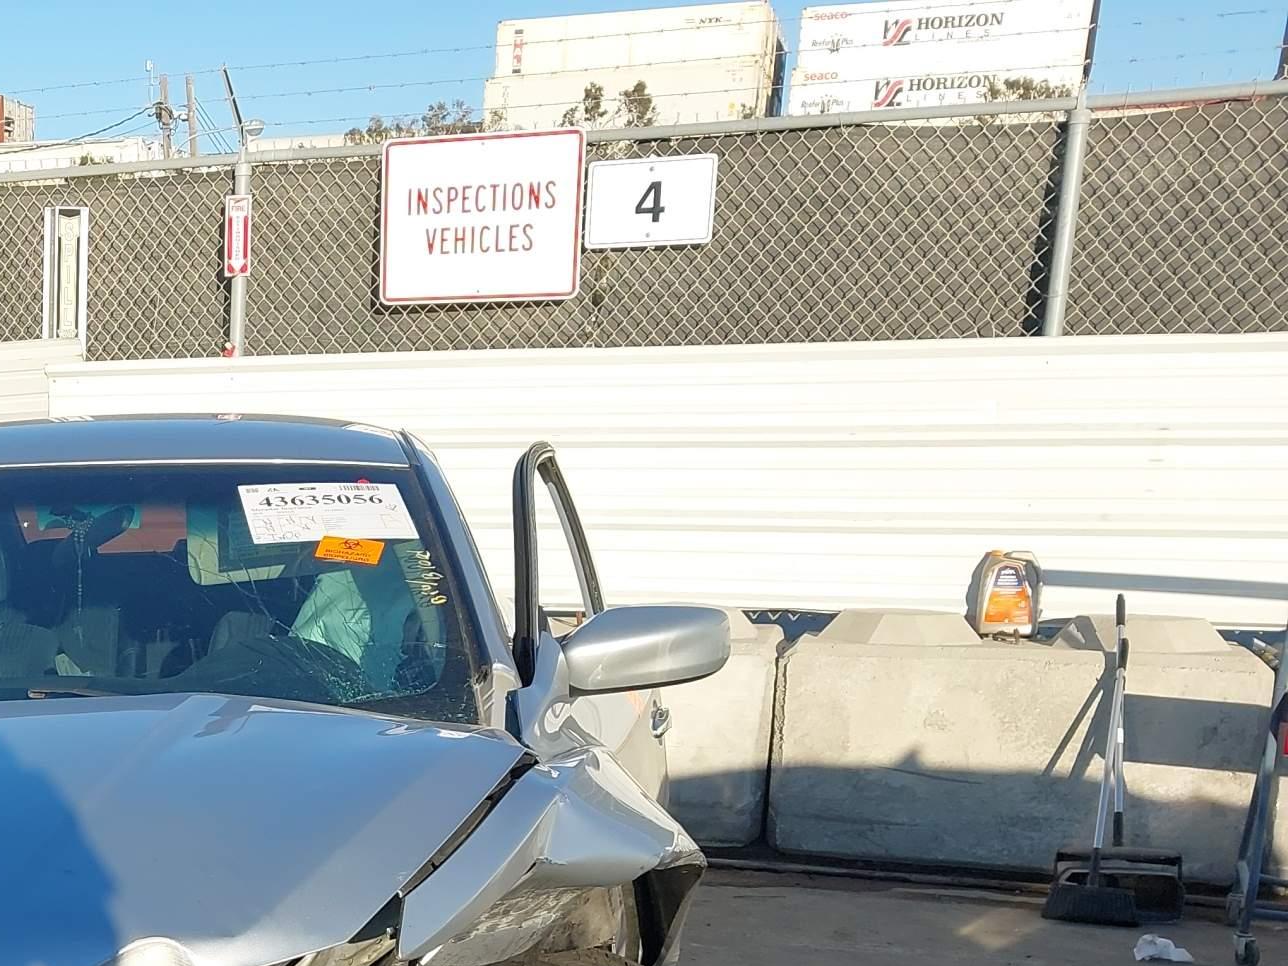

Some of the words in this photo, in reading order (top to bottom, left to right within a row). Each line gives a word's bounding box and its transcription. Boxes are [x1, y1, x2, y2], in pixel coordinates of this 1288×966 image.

[698, 16, 724, 25] NYK
[813, 11, 848, 21] seaco
[917, 12, 1004, 30] HORIZON
[915, 29, 990, 41] LINES
[803, 71, 839, 82] seaco
[908, 74, 996, 92] HORIZON
[906, 90, 985, 103] LINES
[407, 180, 557, 216] INSPECTIONS
[634, 180, 666, 223] 4
[425, 223, 535, 255] VEHICLES
[63, 221, 75, 327] SPILL
[258, 493, 383, 508] 43635056
